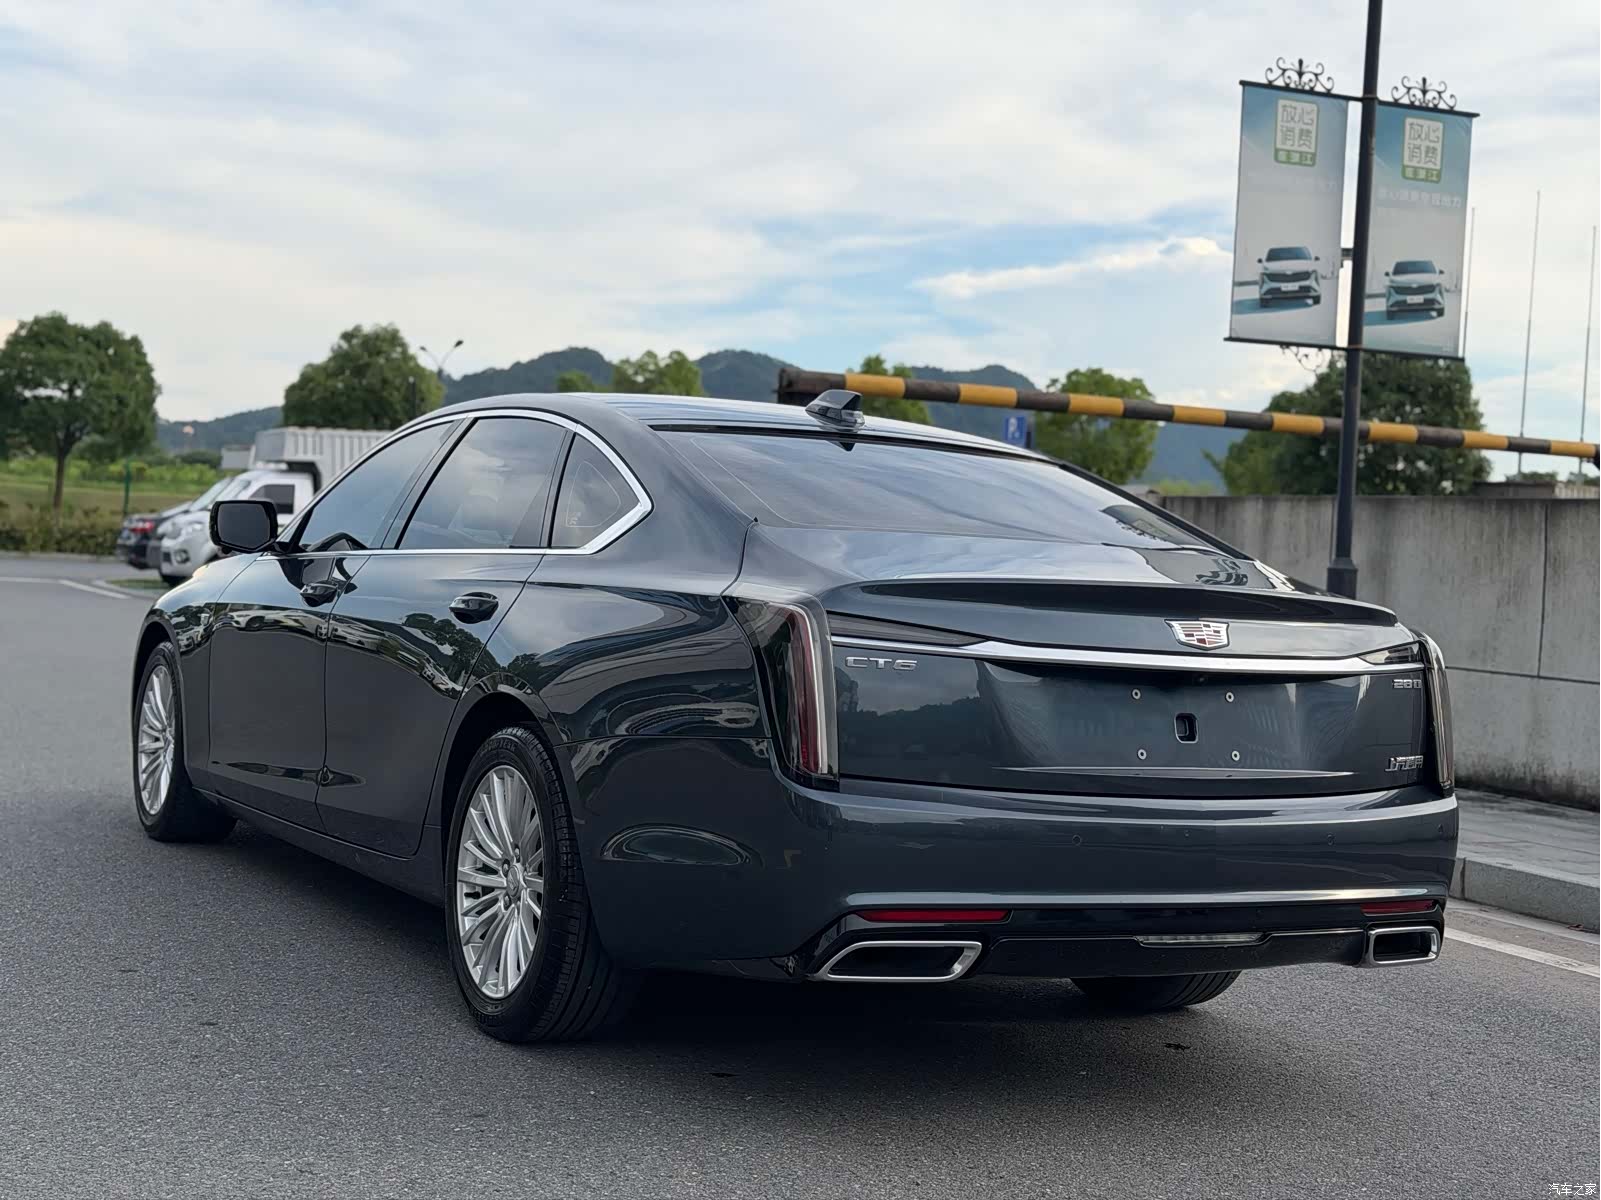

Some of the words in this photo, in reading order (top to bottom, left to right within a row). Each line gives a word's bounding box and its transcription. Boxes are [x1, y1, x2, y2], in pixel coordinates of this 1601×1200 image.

[1281, 104, 1315, 126] 放心
[1280, 125, 1313, 150] 消费
[1408, 122, 1440, 144] 放心
[1407, 142, 1439, 167] 消费
[845, 656, 918, 671] CT6
